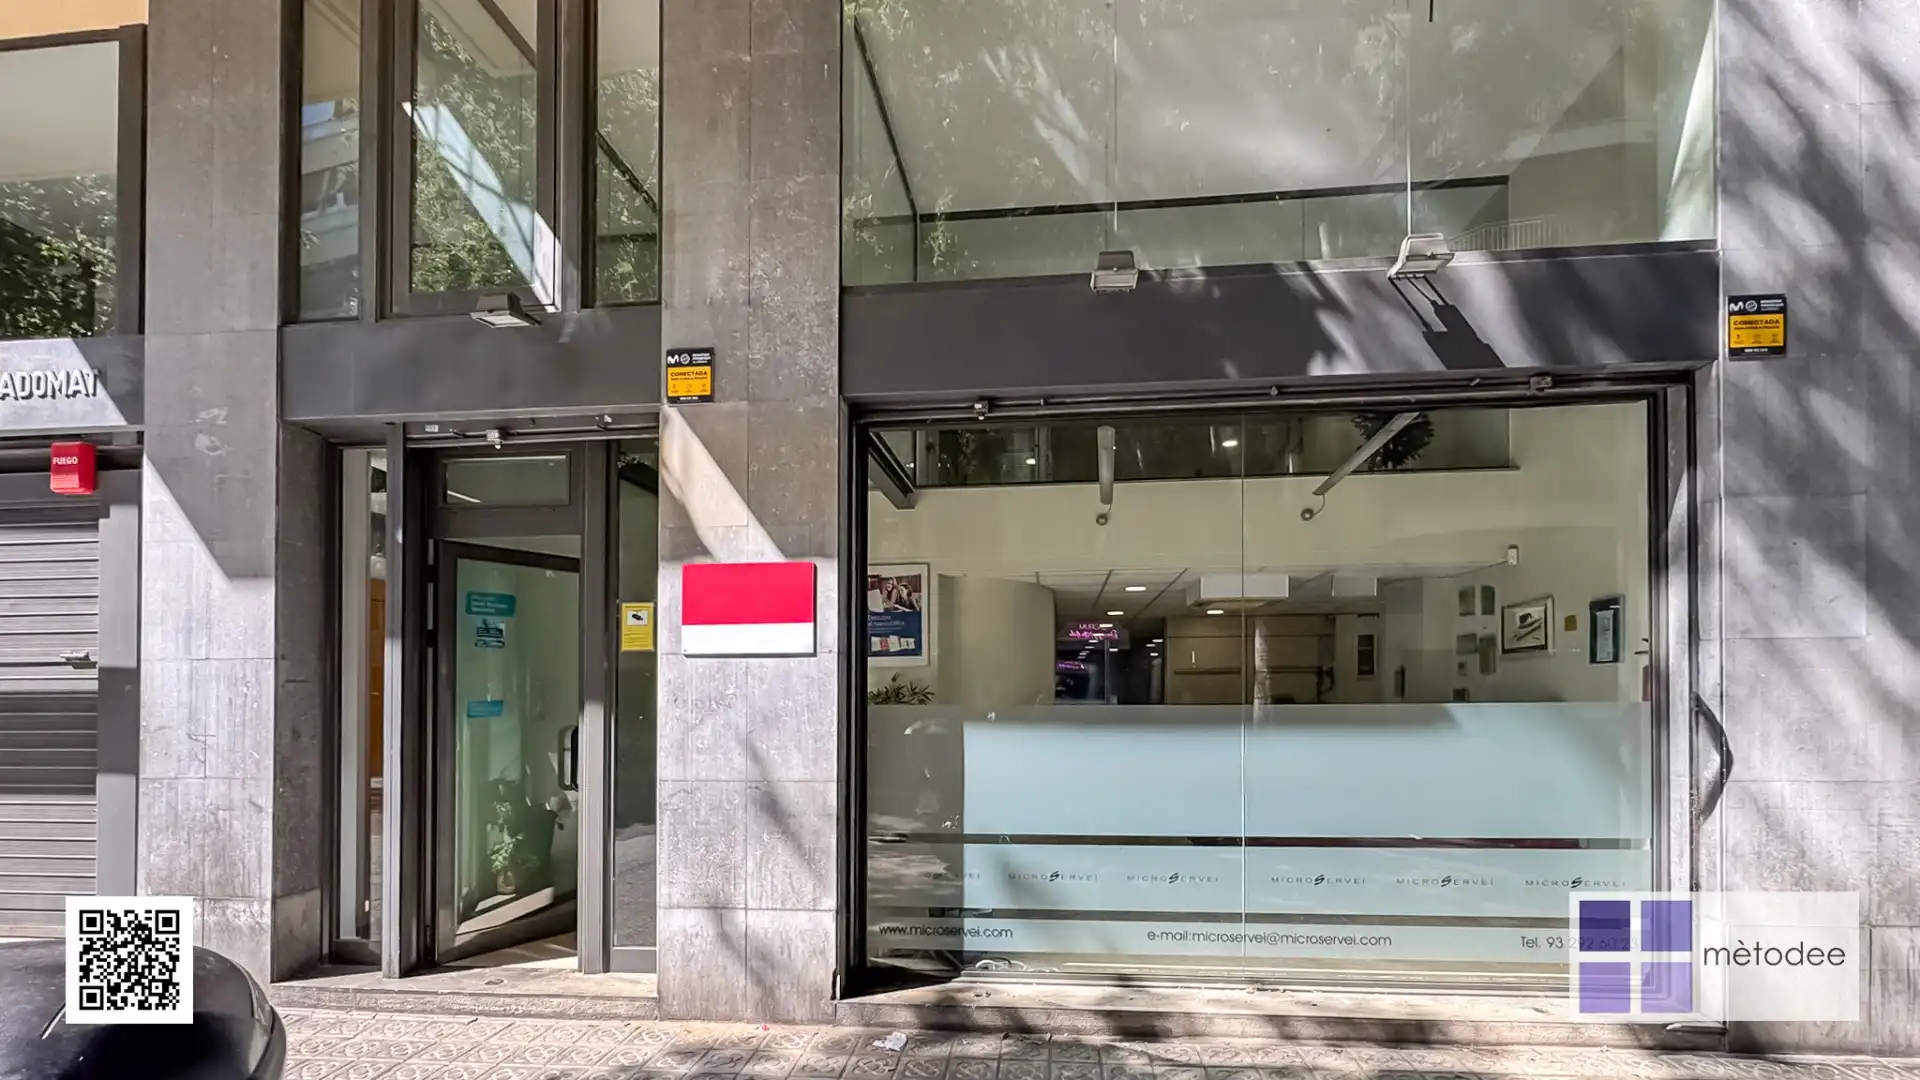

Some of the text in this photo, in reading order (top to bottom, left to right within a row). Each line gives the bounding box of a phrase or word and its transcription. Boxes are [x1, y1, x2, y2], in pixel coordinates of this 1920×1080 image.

[52, 456, 79, 465] FUEGO
[1008, 871, 1098, 882] MICROSERVEI
[1127, 872, 1219, 884] MICROSERVEI
[1271, 874, 1365, 885] MICROSERVEI
[1396, 875, 1494, 887] MICROSERVEI
[879, 924, 1013, 939] www.microservei.com
[1147, 930, 1392, 946] e-mail:microservei@microservei.com
[1520, 936, 1541, 949] Tel.
[1547, 936, 1564, 949] 93
